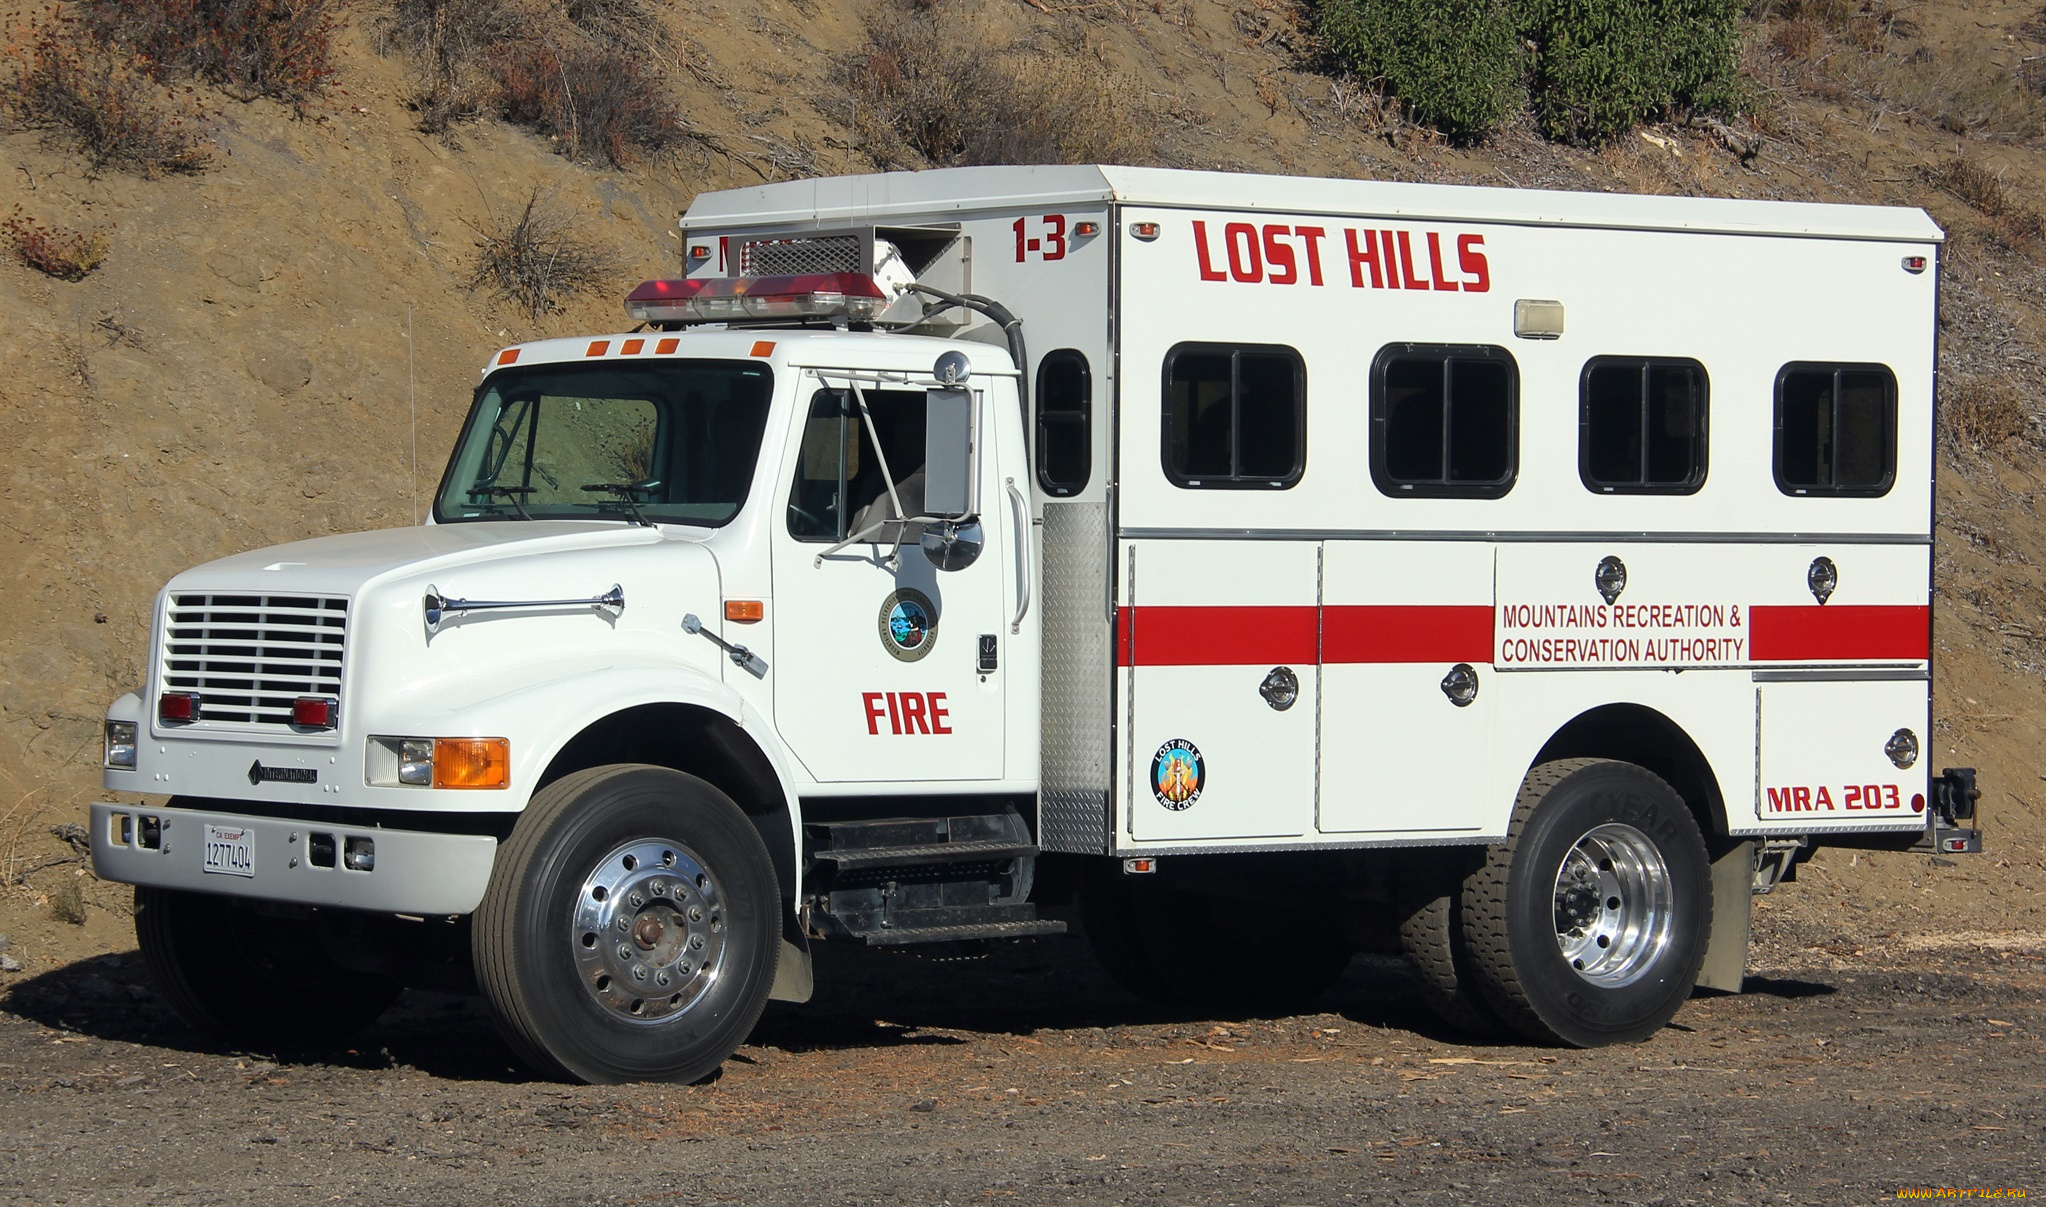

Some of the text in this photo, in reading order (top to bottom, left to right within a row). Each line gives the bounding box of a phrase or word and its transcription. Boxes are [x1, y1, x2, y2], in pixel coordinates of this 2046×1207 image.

[1013, 214, 1066, 263] 1-3
[1192, 220, 1491, 293] LOST HILLS
[1503, 604, 1741, 628] MOUNTAINS RECREATION &
[1502, 638, 1743, 662] CONSERVATION AUTHORITY
[862, 691, 953, 735] FIRE
[1155, 740, 1201, 762] LOST HILLS
[1156, 788, 1201, 810] FIRE CREW
[1767, 784, 1900, 812] MRA 203
[206, 842, 251, 870] 1277404
